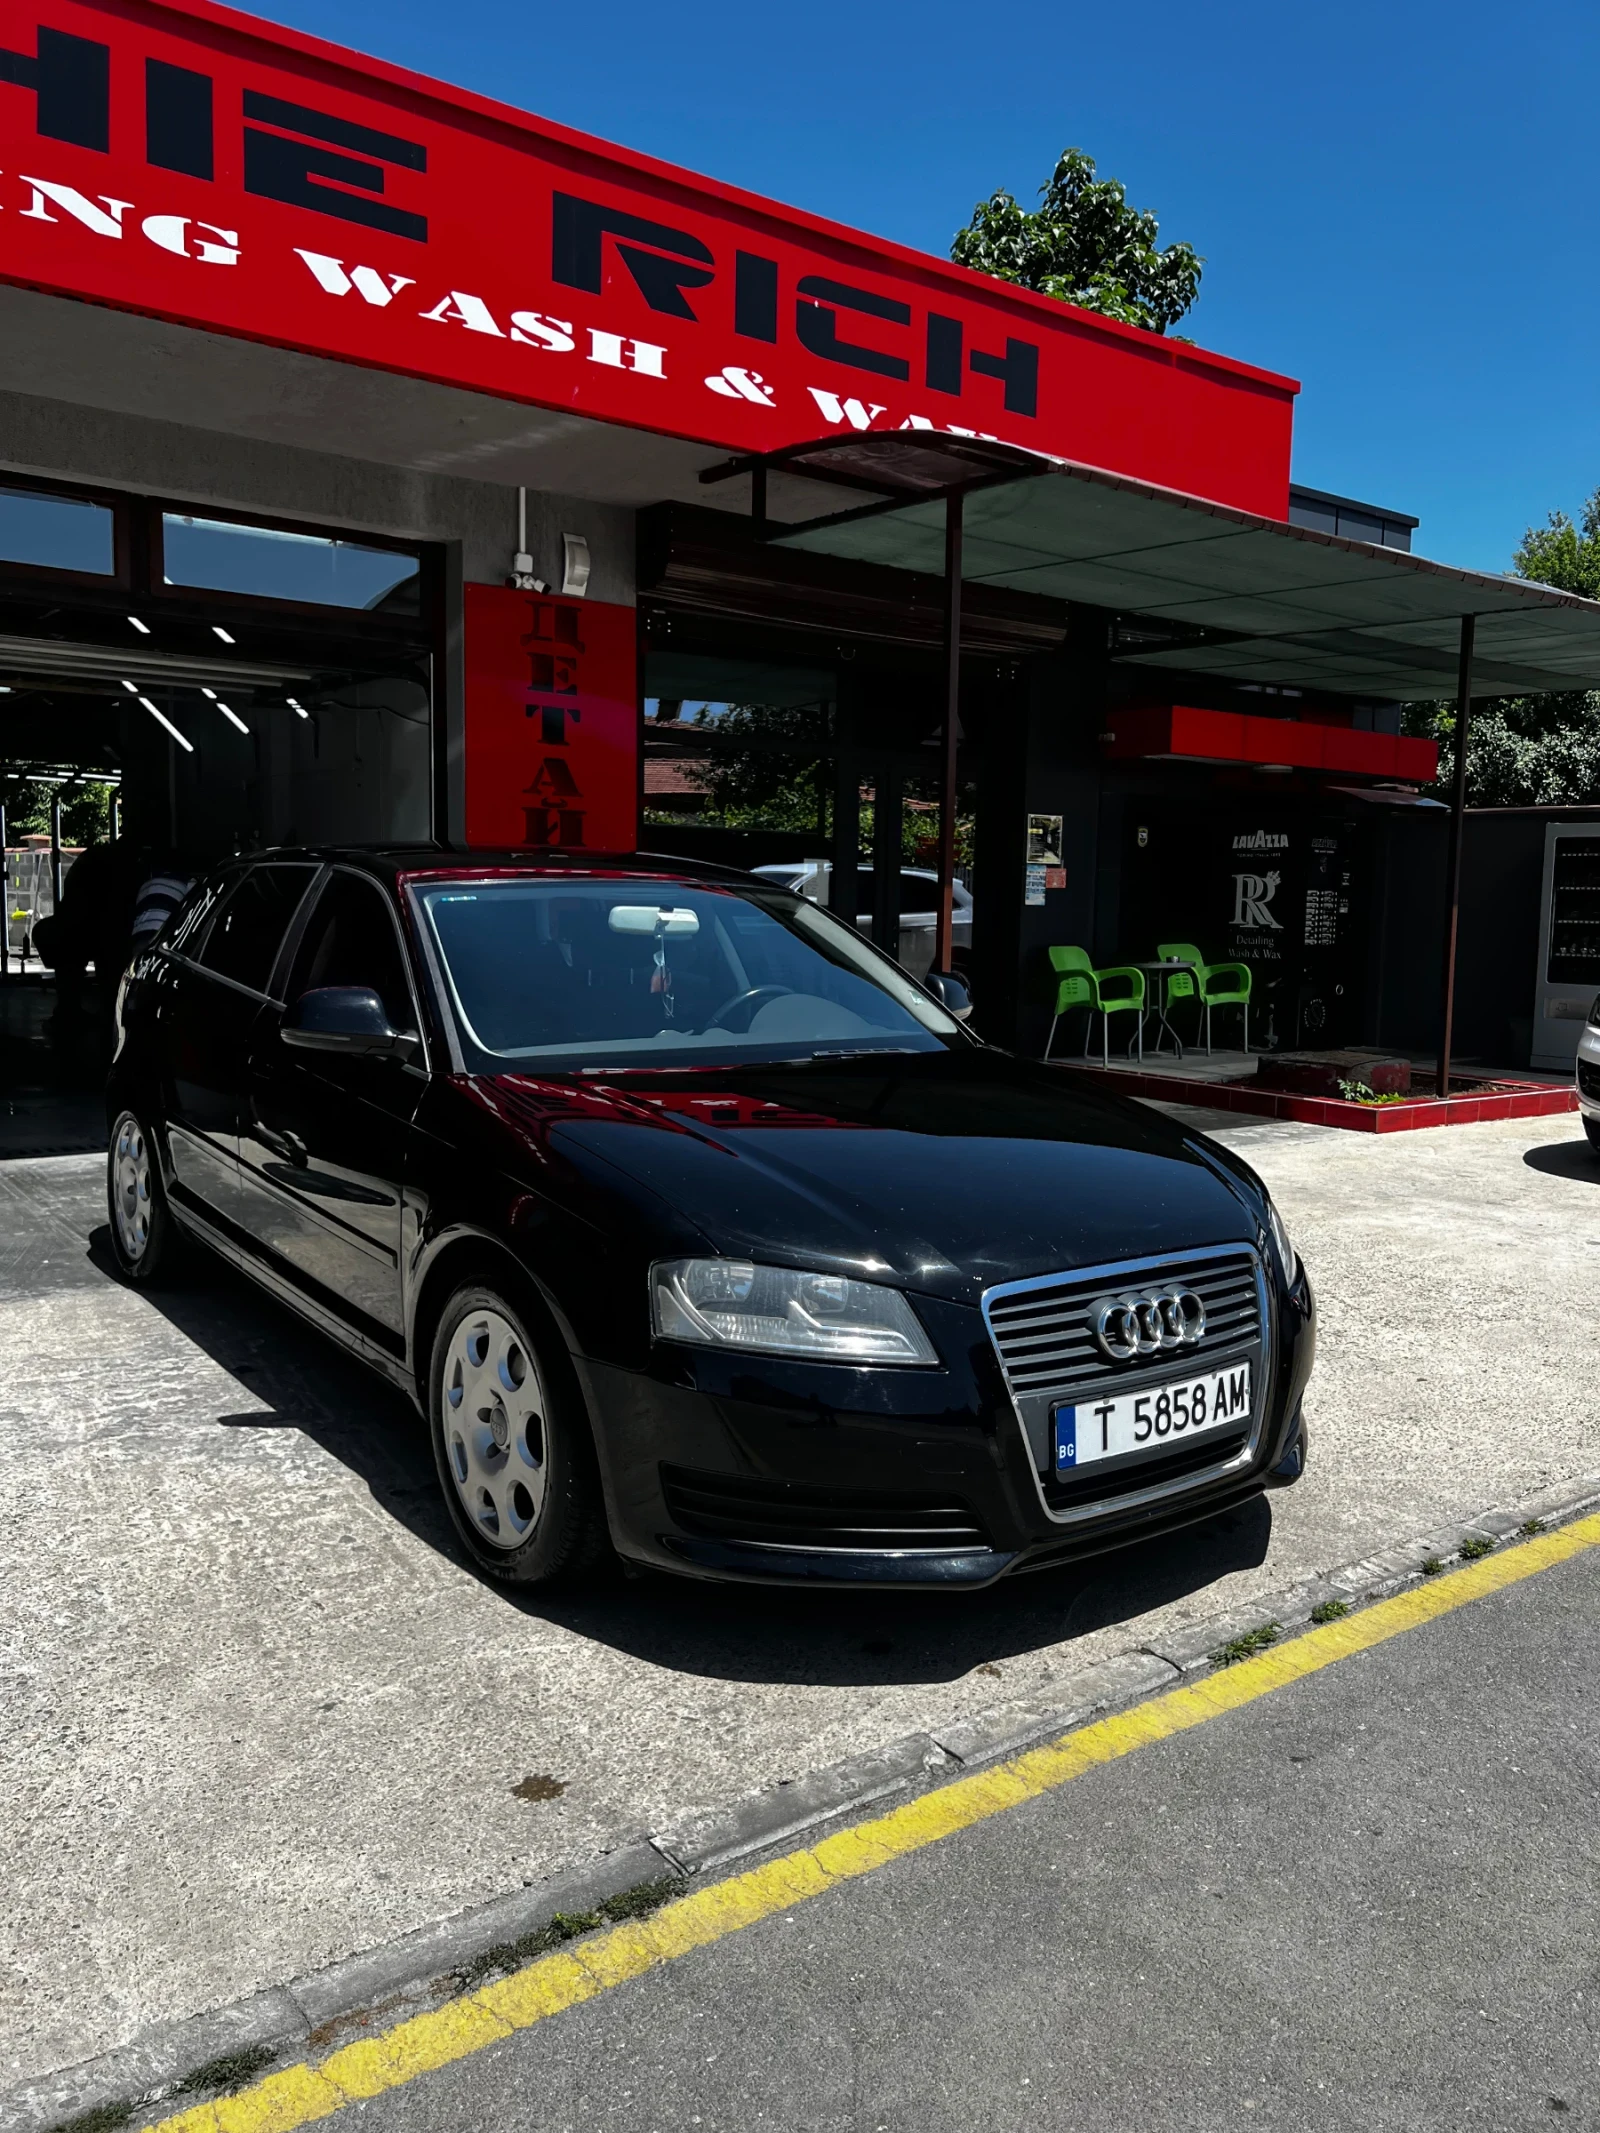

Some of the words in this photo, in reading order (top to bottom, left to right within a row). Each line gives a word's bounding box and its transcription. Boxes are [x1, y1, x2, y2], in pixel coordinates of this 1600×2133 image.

[0, 170, 242, 265] NG
[293, 248, 667, 379] WASH
[704, 366, 777, 407] &
[806, 386, 998, 441] WA
[552, 190, 1039, 418] RICH
[1232, 830, 1289, 849] LAVAZZA
[1236, 934, 1275, 948] Detailing
[1228, 948, 1250, 959] Wash
[1251, 948, 1260, 959] &
[1263, 948, 1282, 960] Wax
[1095, 1404, 1116, 1451] T
[1134, 1384, 1207, 1441] 5858
[1212, 1369, 1245, 1421] AM
[1058, 1443, 1075, 1460] BG
